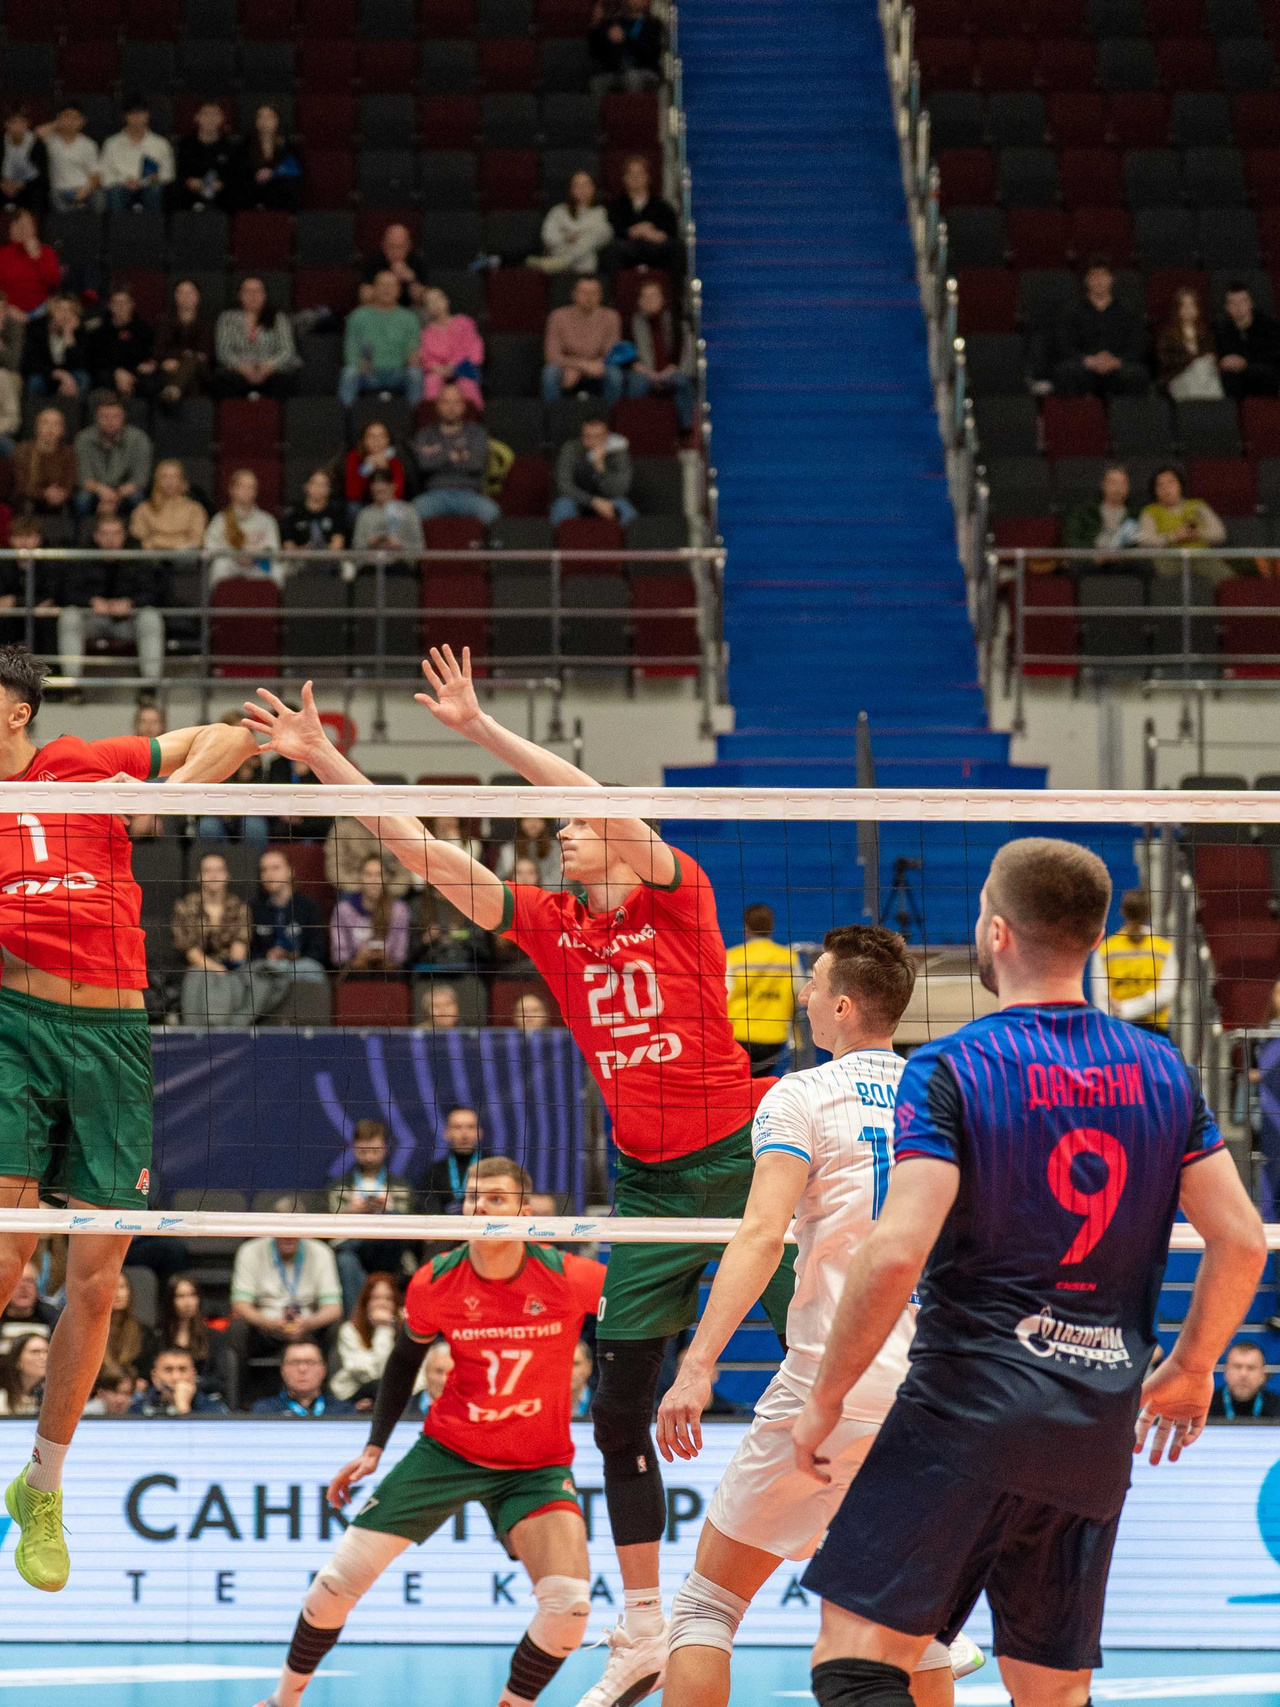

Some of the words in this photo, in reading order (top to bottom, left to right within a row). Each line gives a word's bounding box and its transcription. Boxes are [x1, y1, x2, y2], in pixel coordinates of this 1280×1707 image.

[16, 814, 49, 863] 1
[583, 959, 665, 1027] 20
[595, 1032, 682, 1080] РЖД
[856, 1082, 896, 1109] ВОЛ
[1027, 1063, 1145, 1110] ДАНАНИ
[1047, 1127, 1128, 1266] 9
[452, 1321, 563, 1341] ЛОКОМОТИВ
[481, 1349, 534, 1396] 17
